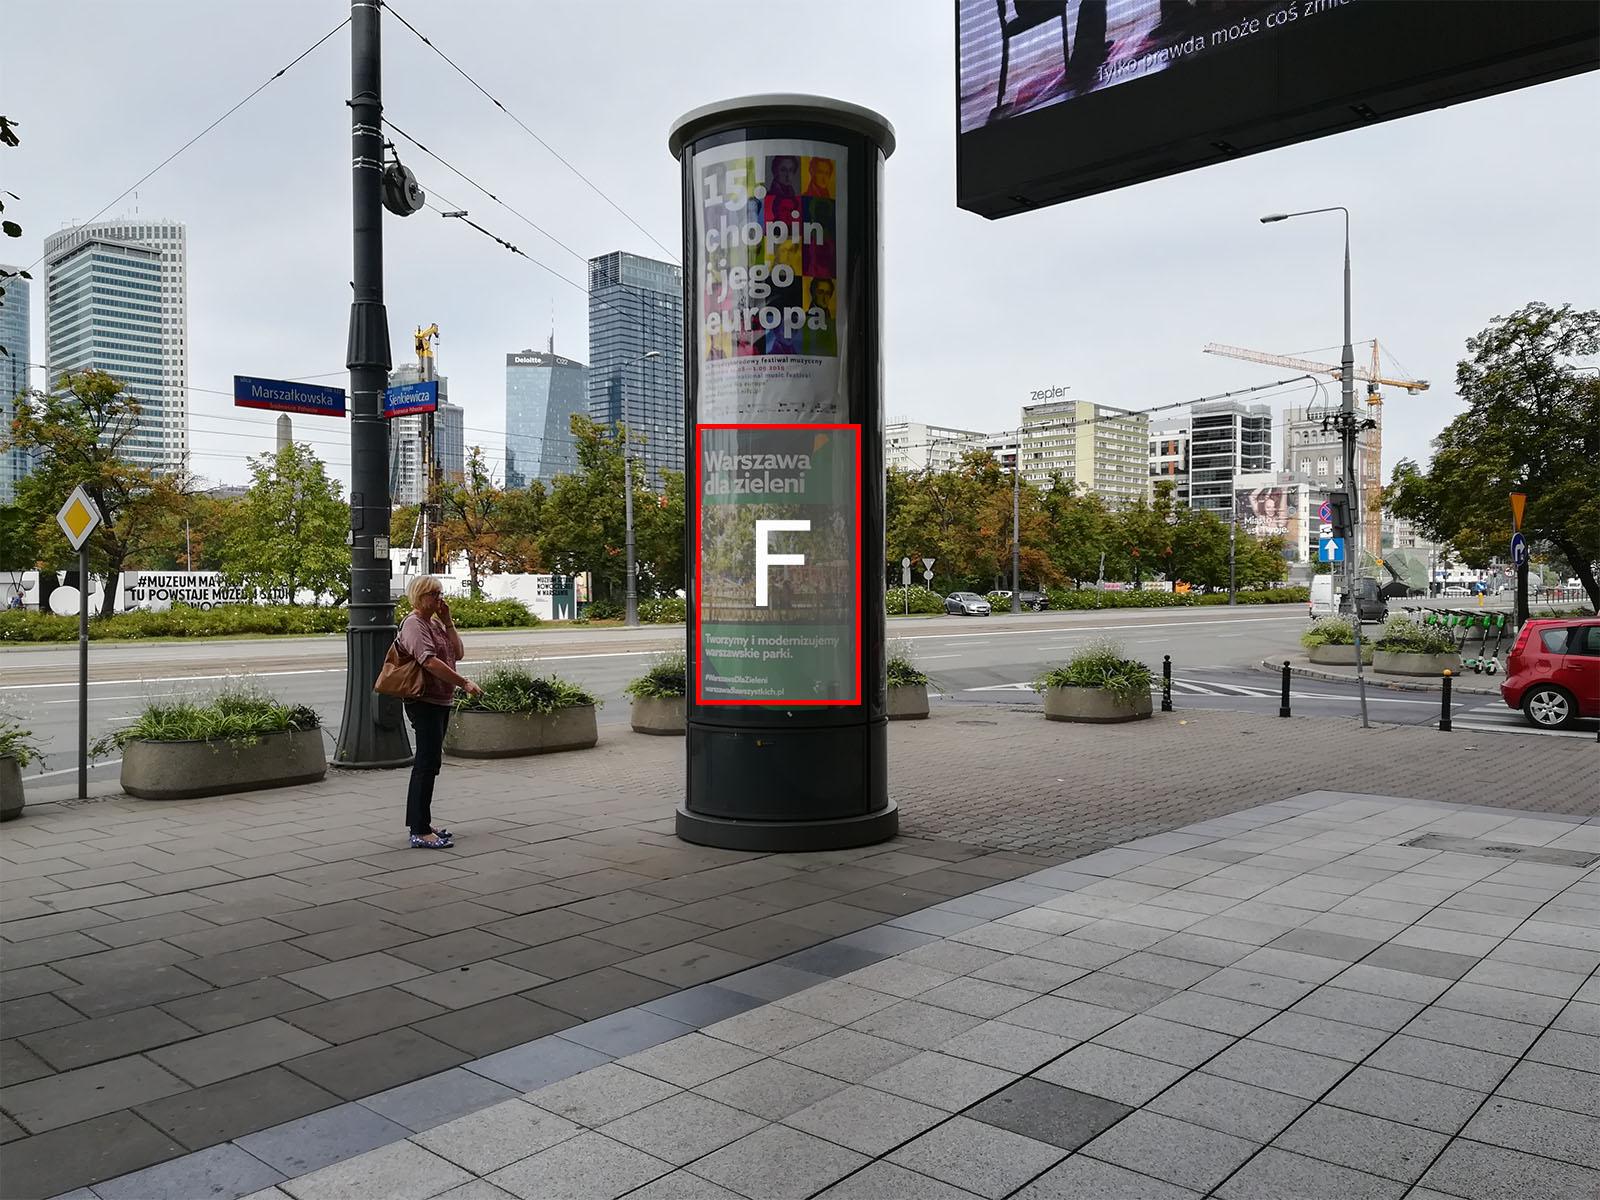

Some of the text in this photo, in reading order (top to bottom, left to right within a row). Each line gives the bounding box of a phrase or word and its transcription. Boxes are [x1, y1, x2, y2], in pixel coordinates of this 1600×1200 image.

[1097, 57, 1138, 86] Tylko
[1143, 36, 1205, 71] prawda
[1211, 17, 1260, 46] może
[1265, 1, 1298, 28] coś
[703, 169, 767, 211] 15.
[706, 210, 824, 255] chopin
[706, 259, 794, 303] i jego
[706, 306, 827, 339] europa
[514, 356, 542, 364] Deloitte
[790, 358, 822, 367] muzyczny
[251, 384, 333, 406] Marszałkowska
[389, 390, 430, 407] Sienkiewicza
[1030, 385, 1071, 402] zepter
[704, 450, 811, 473] Warszawa
[704, 471, 806, 495] dla zieleni
[138, 576, 196, 588] #MUZEUM
[461, 580, 484, 588] ERO
[130, 589, 145, 601] TU
[149, 589, 209, 601] POWSTAJE
[705, 633, 840, 648] Tworzymy i modernizujemy
[705, 648, 794, 661] warszawskie parki.
